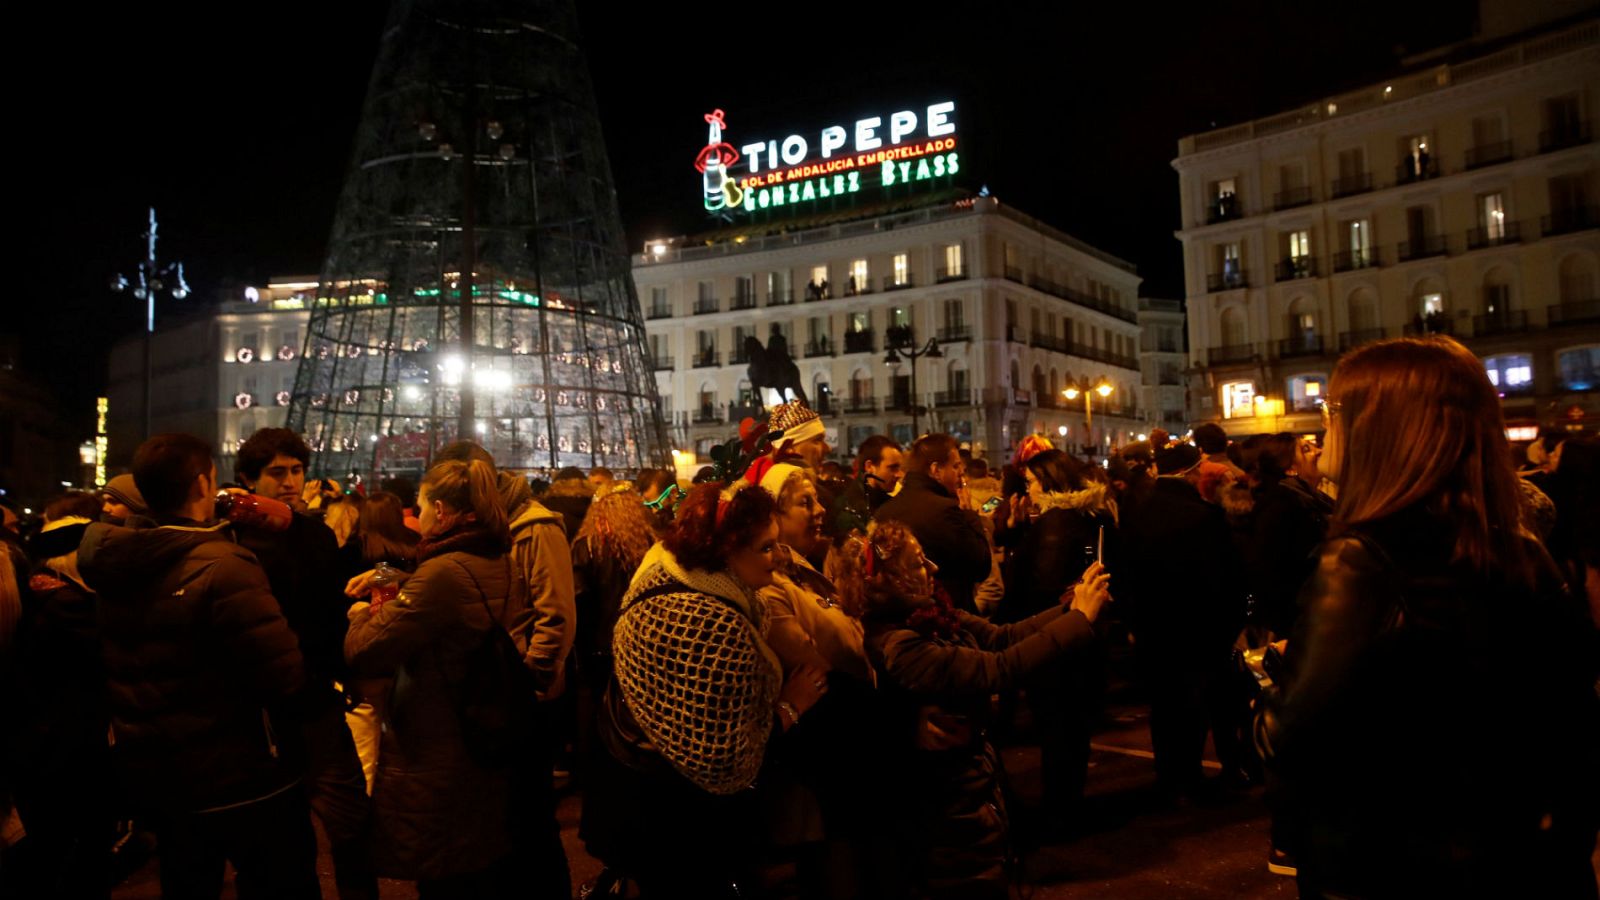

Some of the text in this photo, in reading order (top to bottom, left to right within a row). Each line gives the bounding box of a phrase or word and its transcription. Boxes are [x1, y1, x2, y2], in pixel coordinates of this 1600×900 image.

[741, 138, 955, 189] SOL DE ANDALUCIA EMBOTELLADO
[742, 101, 955, 173] TIO PEPE
[743, 152, 959, 211] GONZALEZ BYASS
